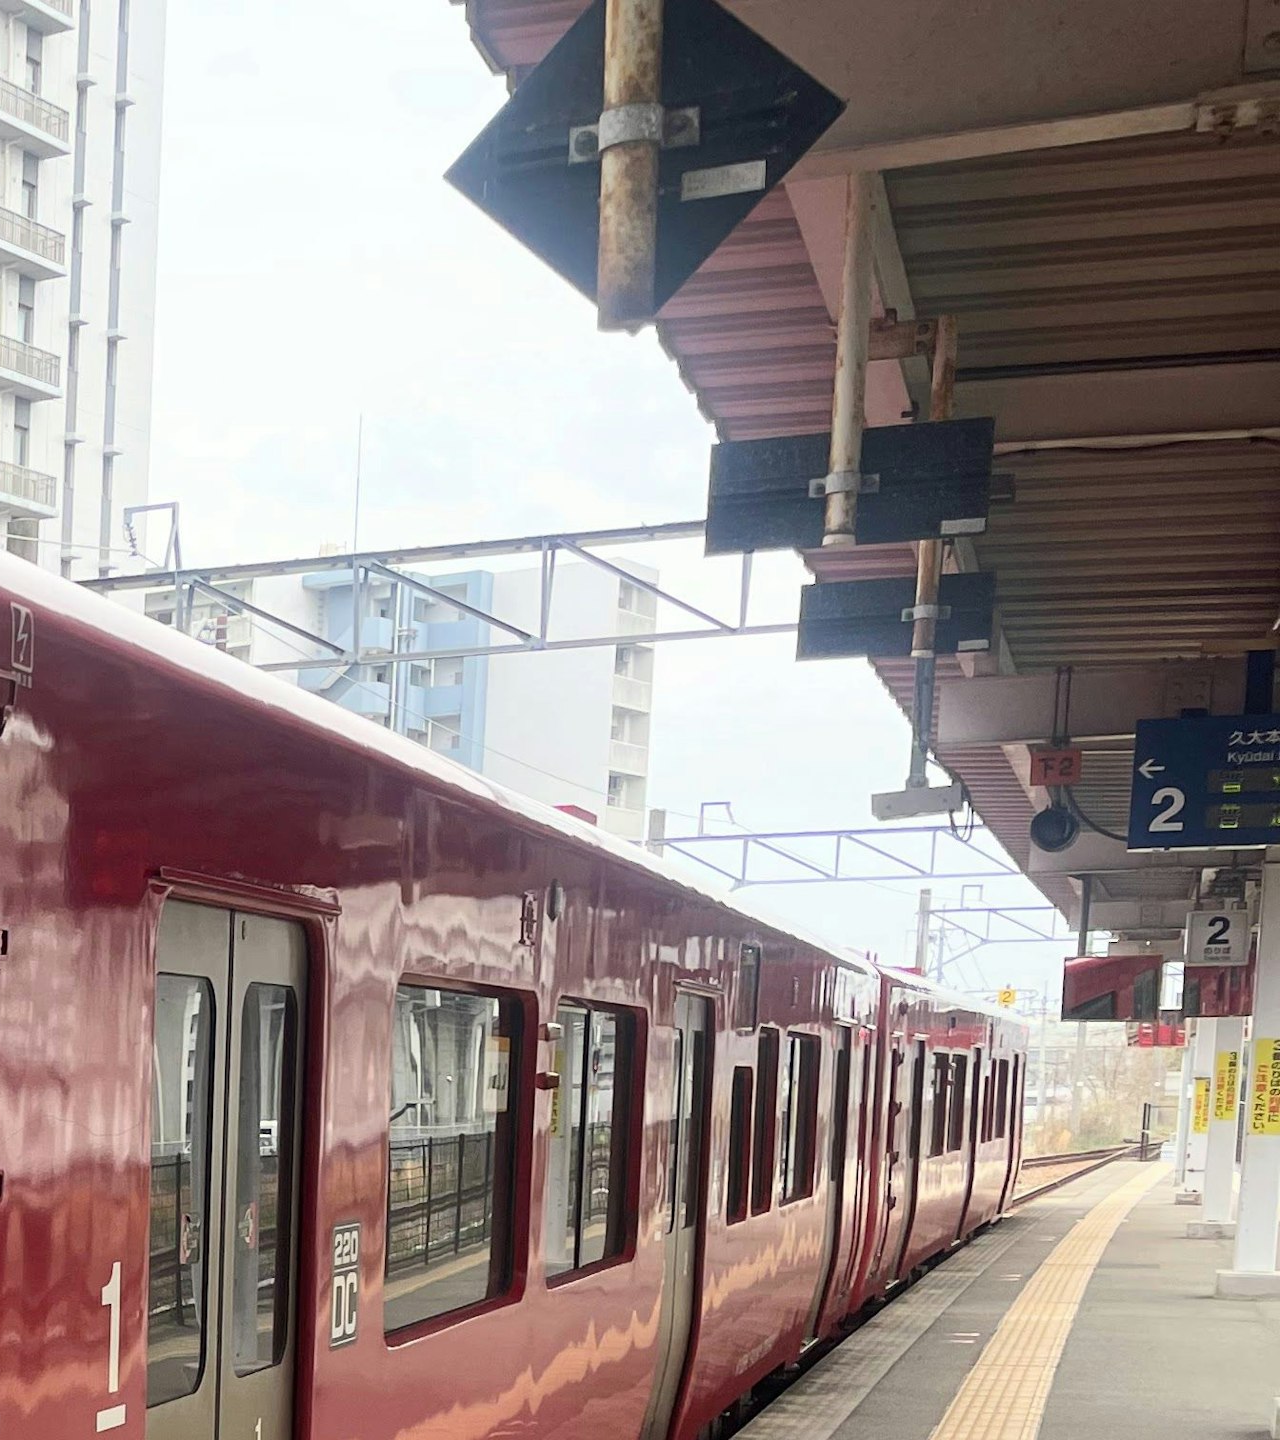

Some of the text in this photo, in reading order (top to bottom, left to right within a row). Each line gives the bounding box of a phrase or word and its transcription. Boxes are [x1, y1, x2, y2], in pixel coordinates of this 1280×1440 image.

[1148, 787, 1186, 832] 2
[1207, 916, 1230, 945] 2
[1002, 990, 1012, 1003] 2
[333, 1230, 359, 1265] 220
[331, 1270, 358, 1340] DC
[101, 1261, 122, 1393] 1
